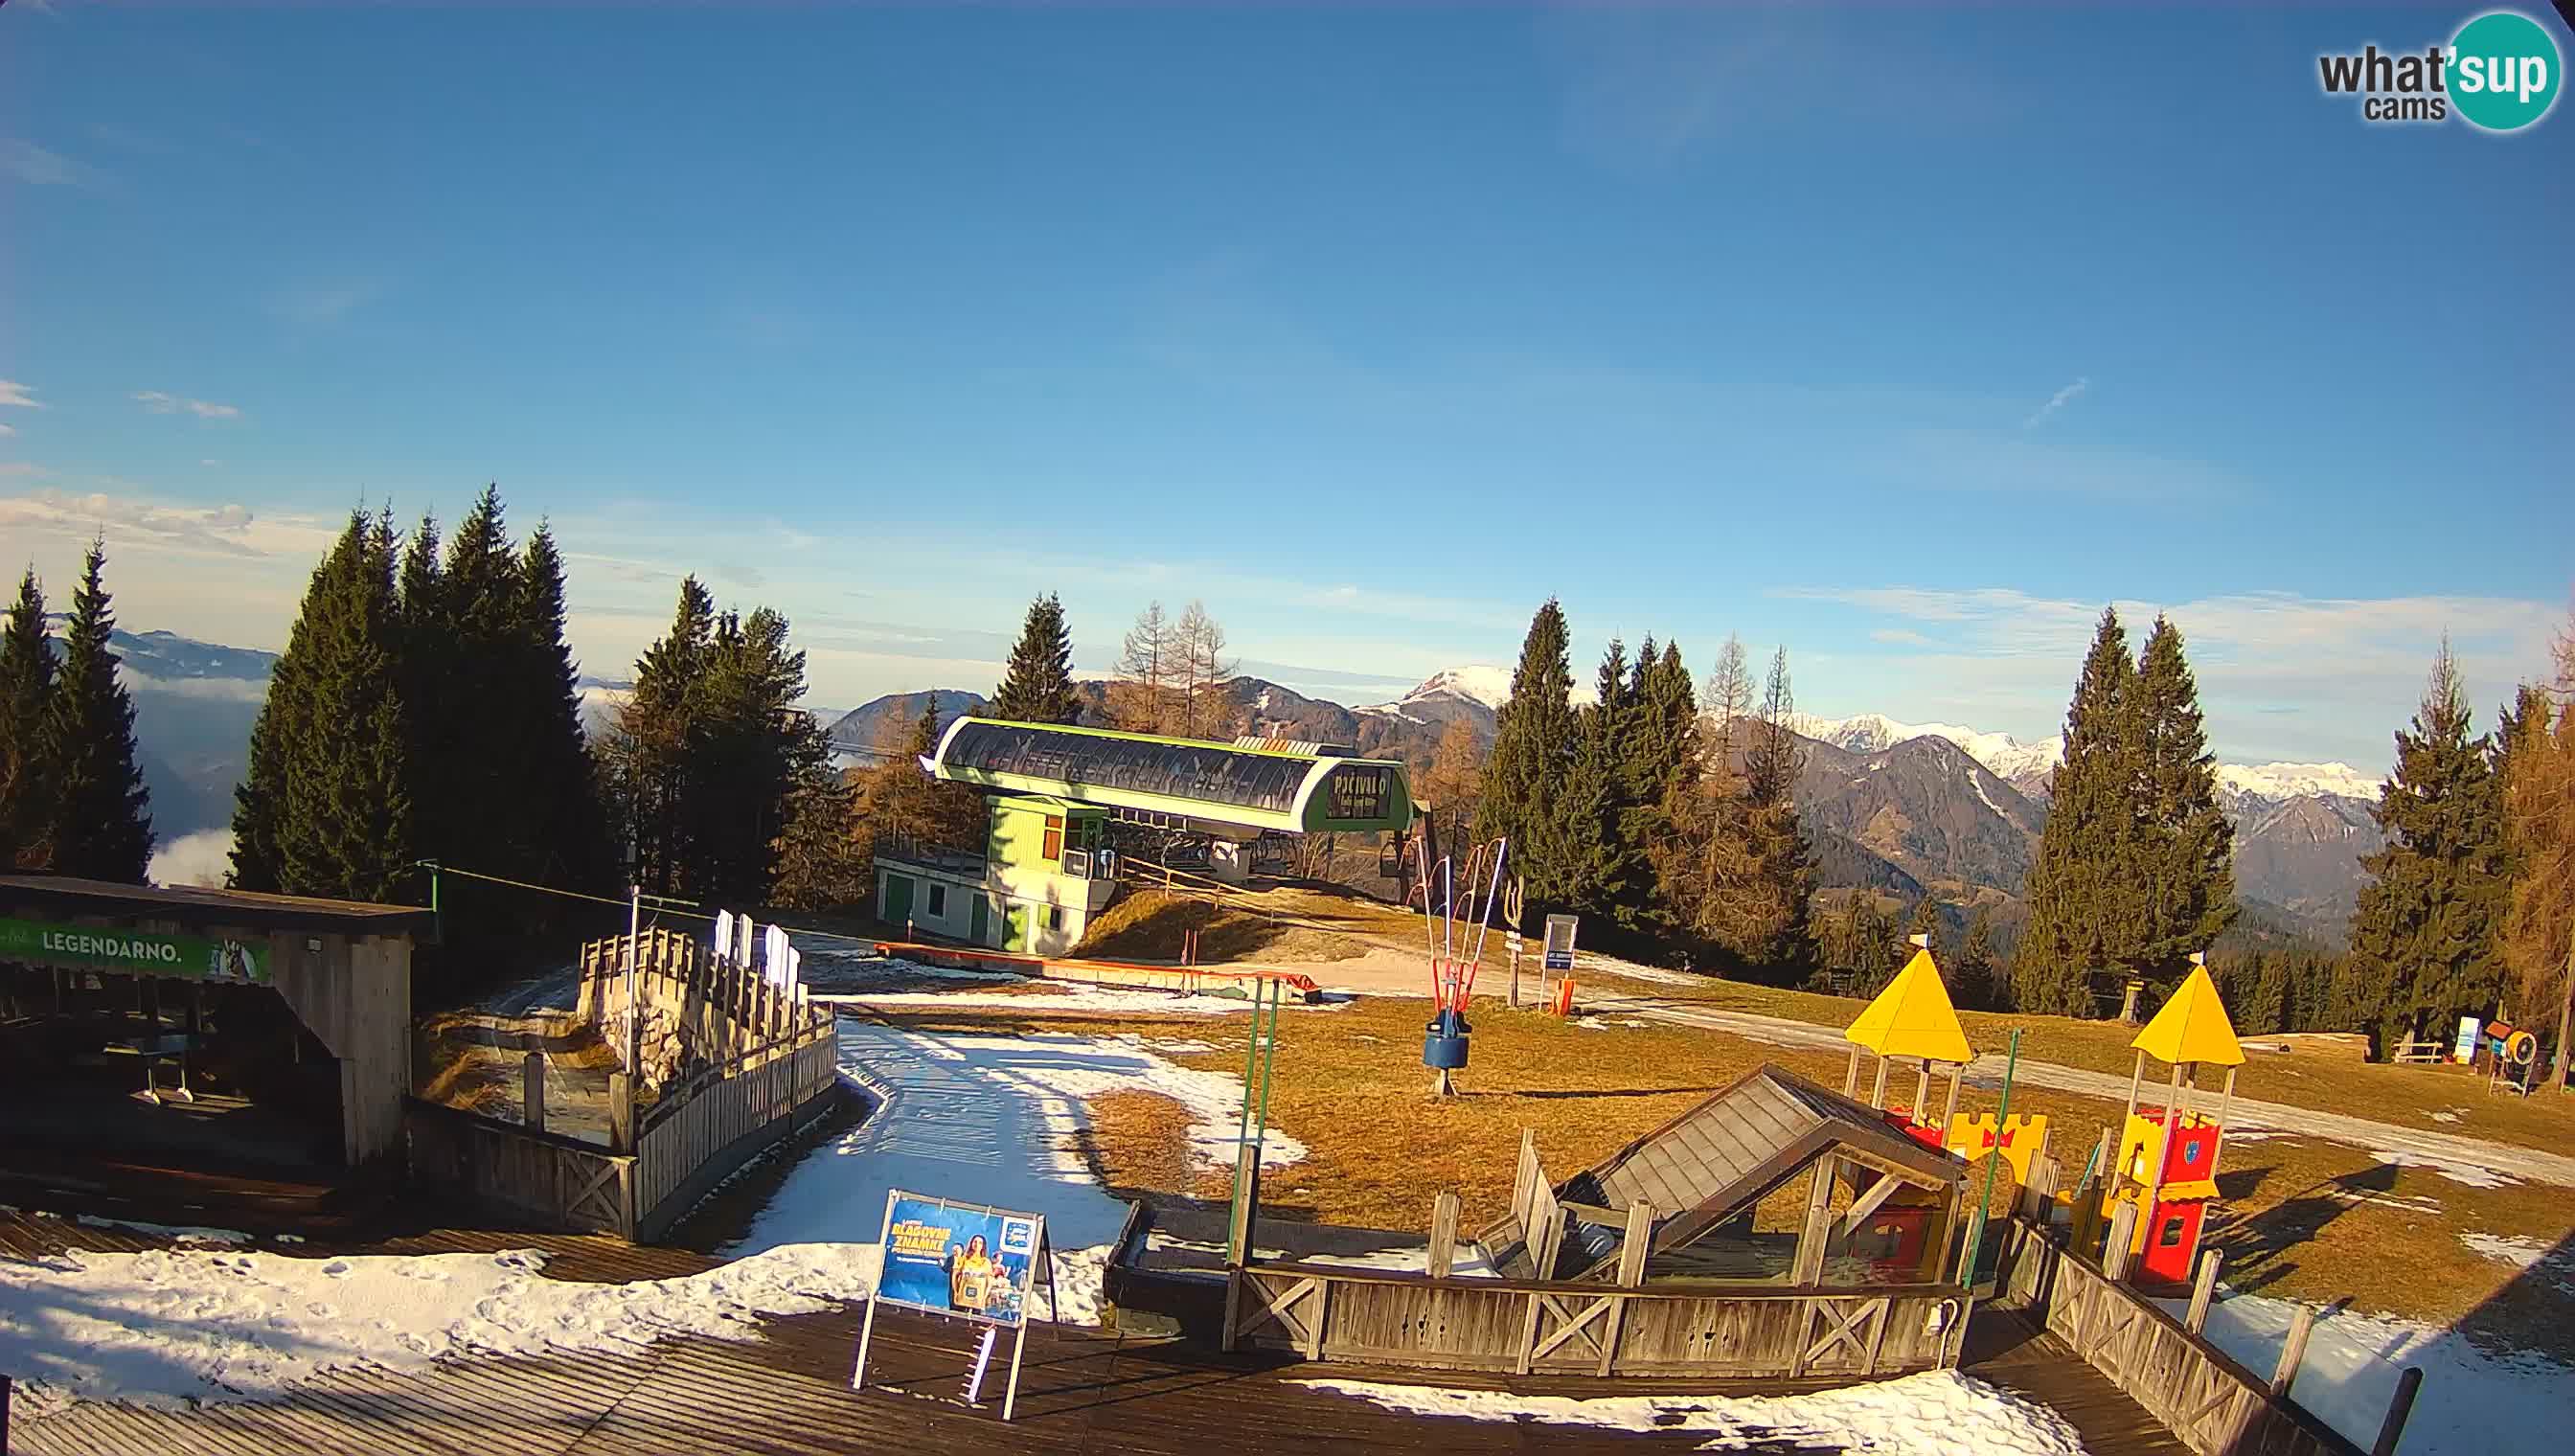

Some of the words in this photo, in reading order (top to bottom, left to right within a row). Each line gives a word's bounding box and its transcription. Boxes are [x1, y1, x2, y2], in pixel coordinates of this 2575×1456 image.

[42, 931, 182, 963] LEGENDARNO.
[891, 1223, 951, 1240] BLAGOVNE
[894, 1235, 946, 1252] ZNAMKE
